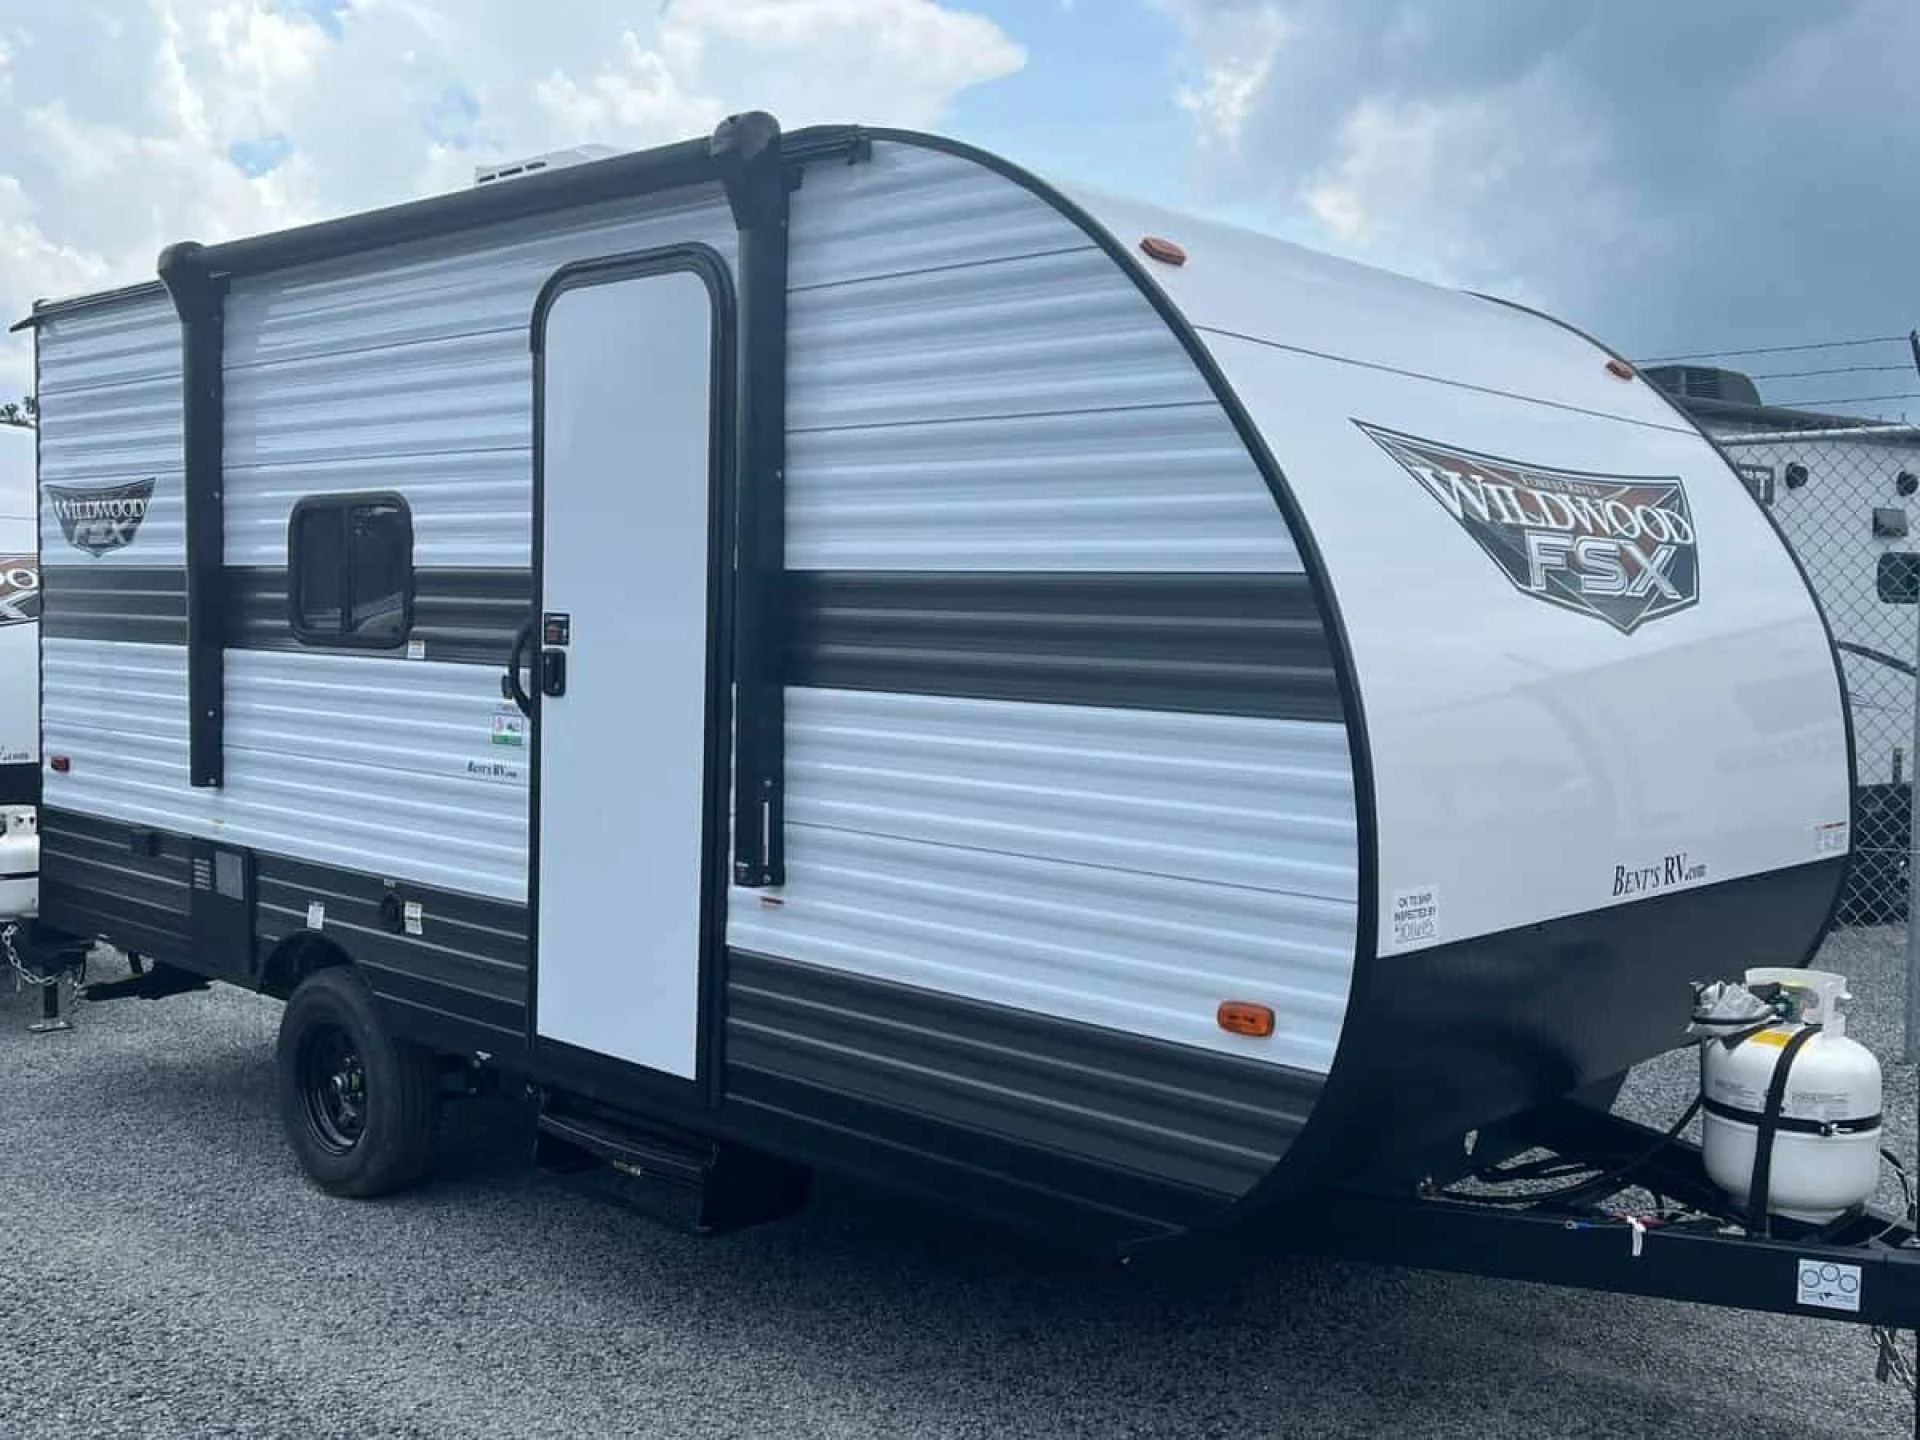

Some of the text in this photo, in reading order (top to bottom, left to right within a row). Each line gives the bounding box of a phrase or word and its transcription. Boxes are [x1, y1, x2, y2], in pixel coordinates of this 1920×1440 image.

[55, 498, 147, 519] WILDWOOD
[1412, 466, 1693, 544] WILDWOOD
[1524, 529, 1682, 600] FSX
